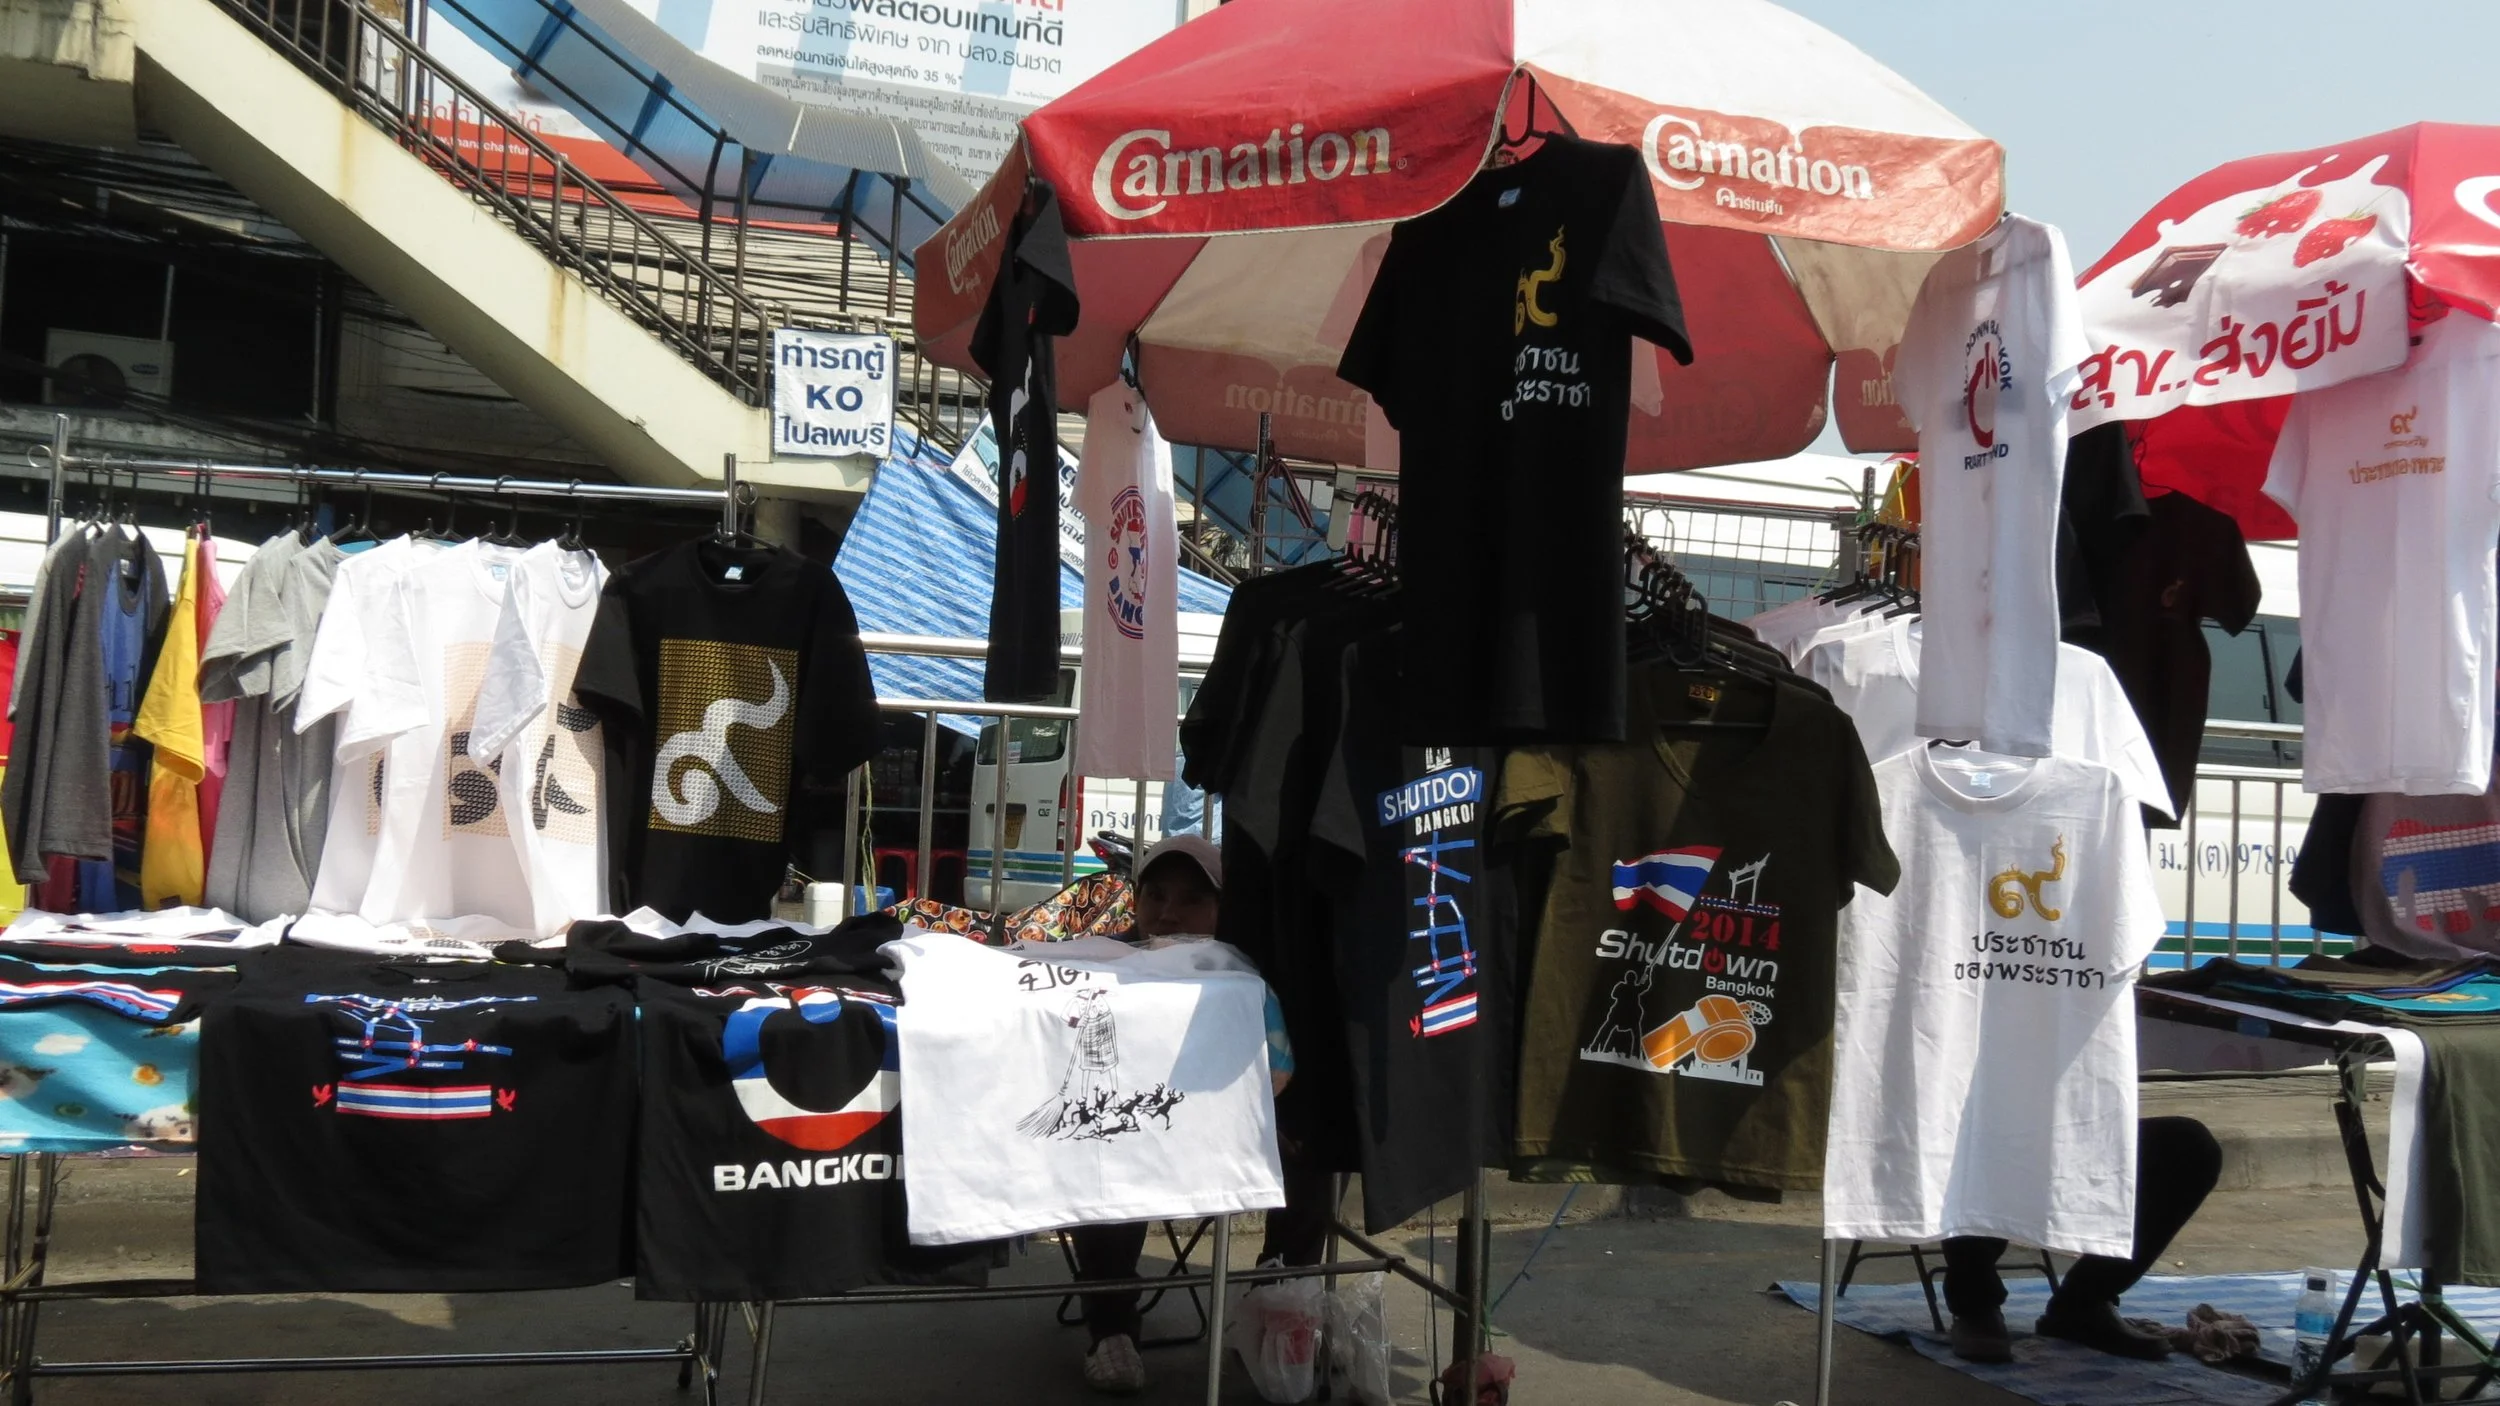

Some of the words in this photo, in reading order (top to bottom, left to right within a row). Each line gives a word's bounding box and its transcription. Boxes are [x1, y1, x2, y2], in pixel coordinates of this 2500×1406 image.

[918, 35, 950, 55] จาก
[923, 70, 939, 82] 35
[1091, 123, 1392, 220] Carnation
[1642, 113, 1875, 201] Carnation
[944, 202, 1001, 296] Carnation
[781, 337, 887, 380] ท่ารถตู้
[806, 384, 863, 411] KO
[779, 415, 886, 448] ไปลพบุรี
[1690, 910, 1782, 951] 2014
[1971, 930, 2087, 961] ประชาชน
[1705, 975, 1776, 999] Bangkok
[1954, 961, 2105, 990] ของพระราชา
